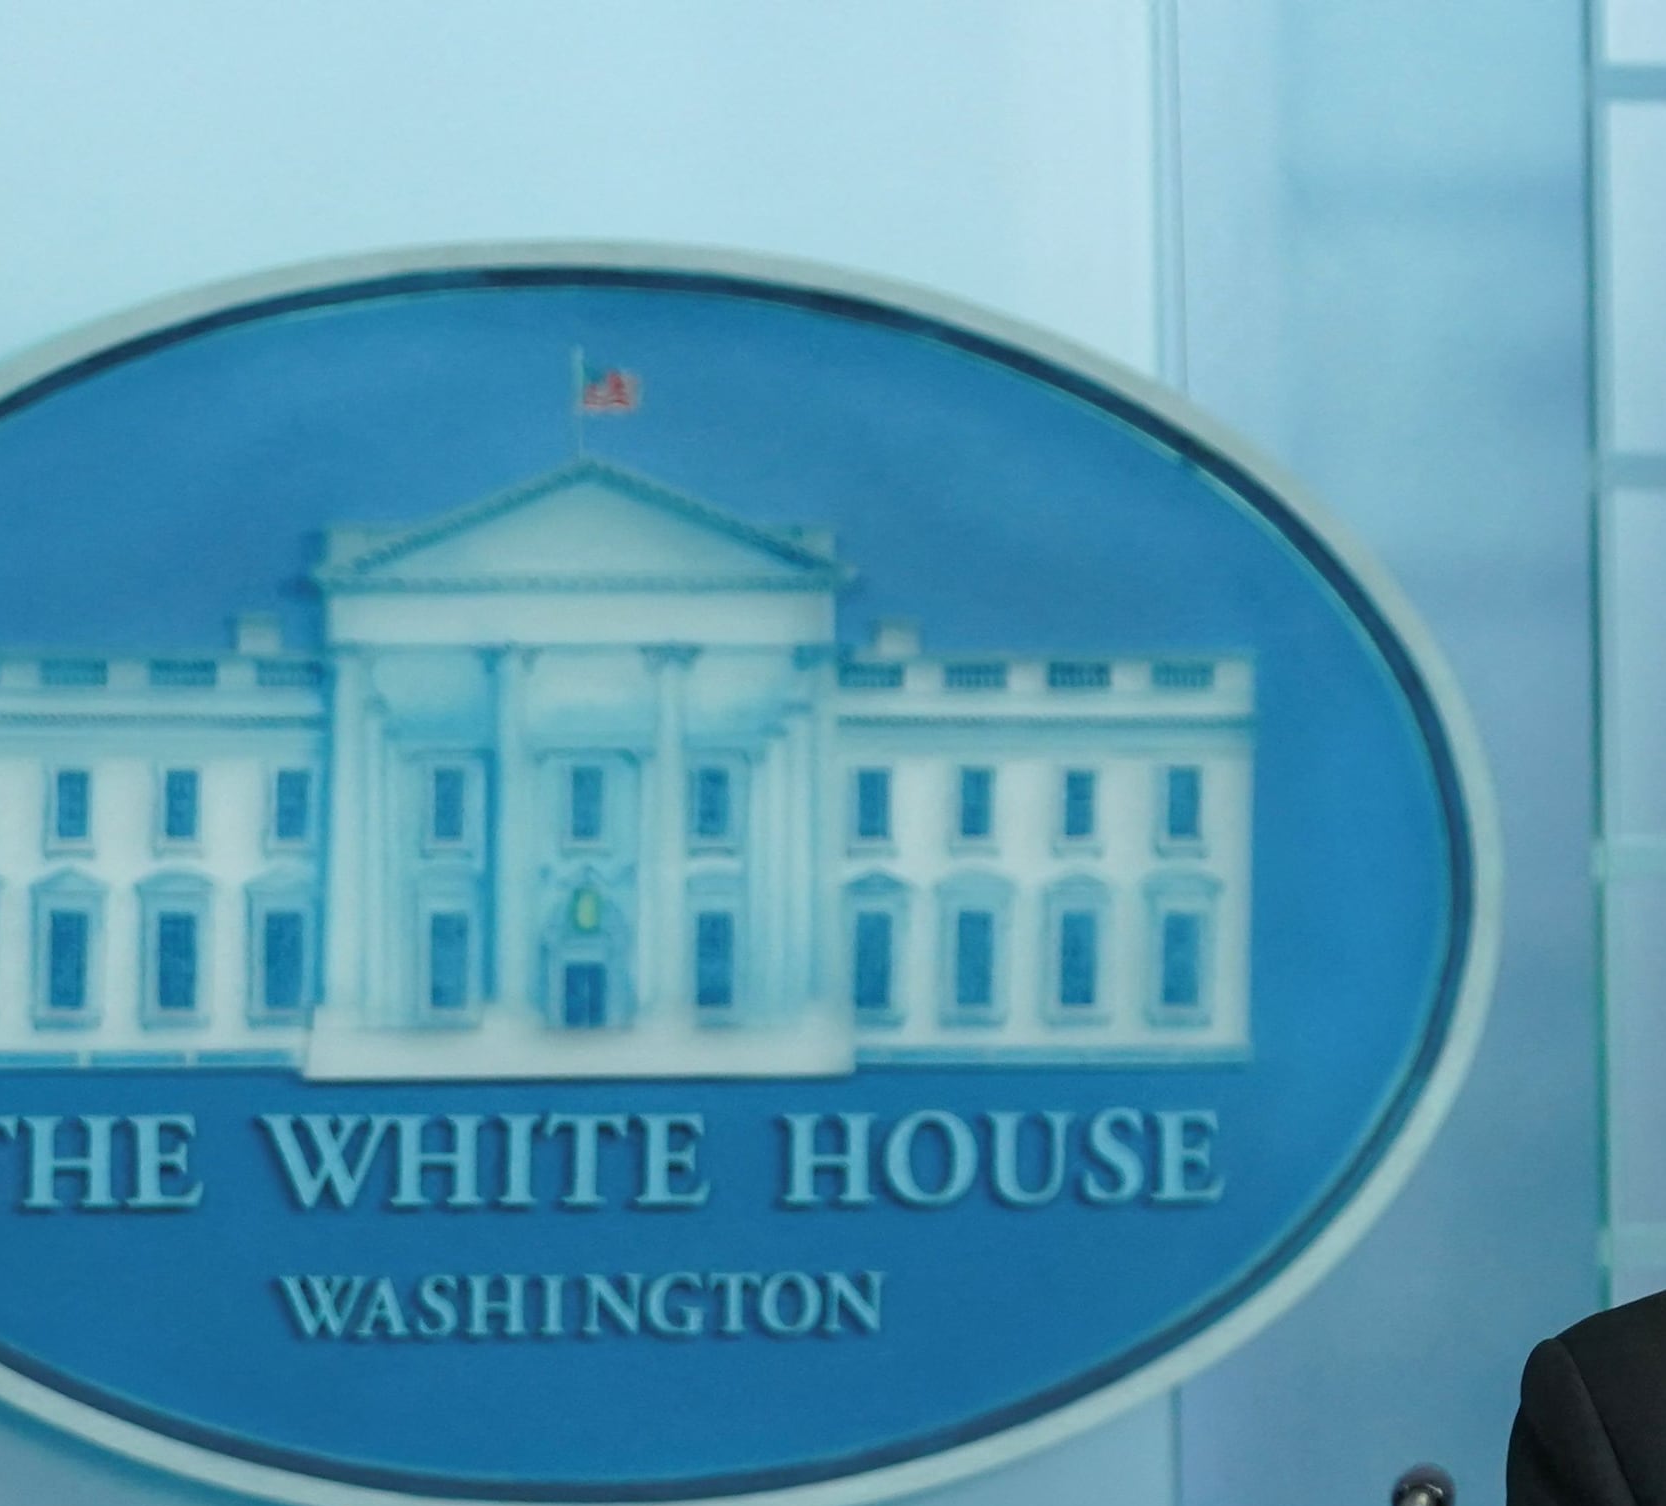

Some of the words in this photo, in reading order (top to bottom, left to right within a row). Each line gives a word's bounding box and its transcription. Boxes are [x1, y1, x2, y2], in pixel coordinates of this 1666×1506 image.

[258, 1111, 711, 1208] WHITE
[780, 1105, 1226, 1205] HOUSE
[278, 1269, 886, 1337] WASHINGTON
